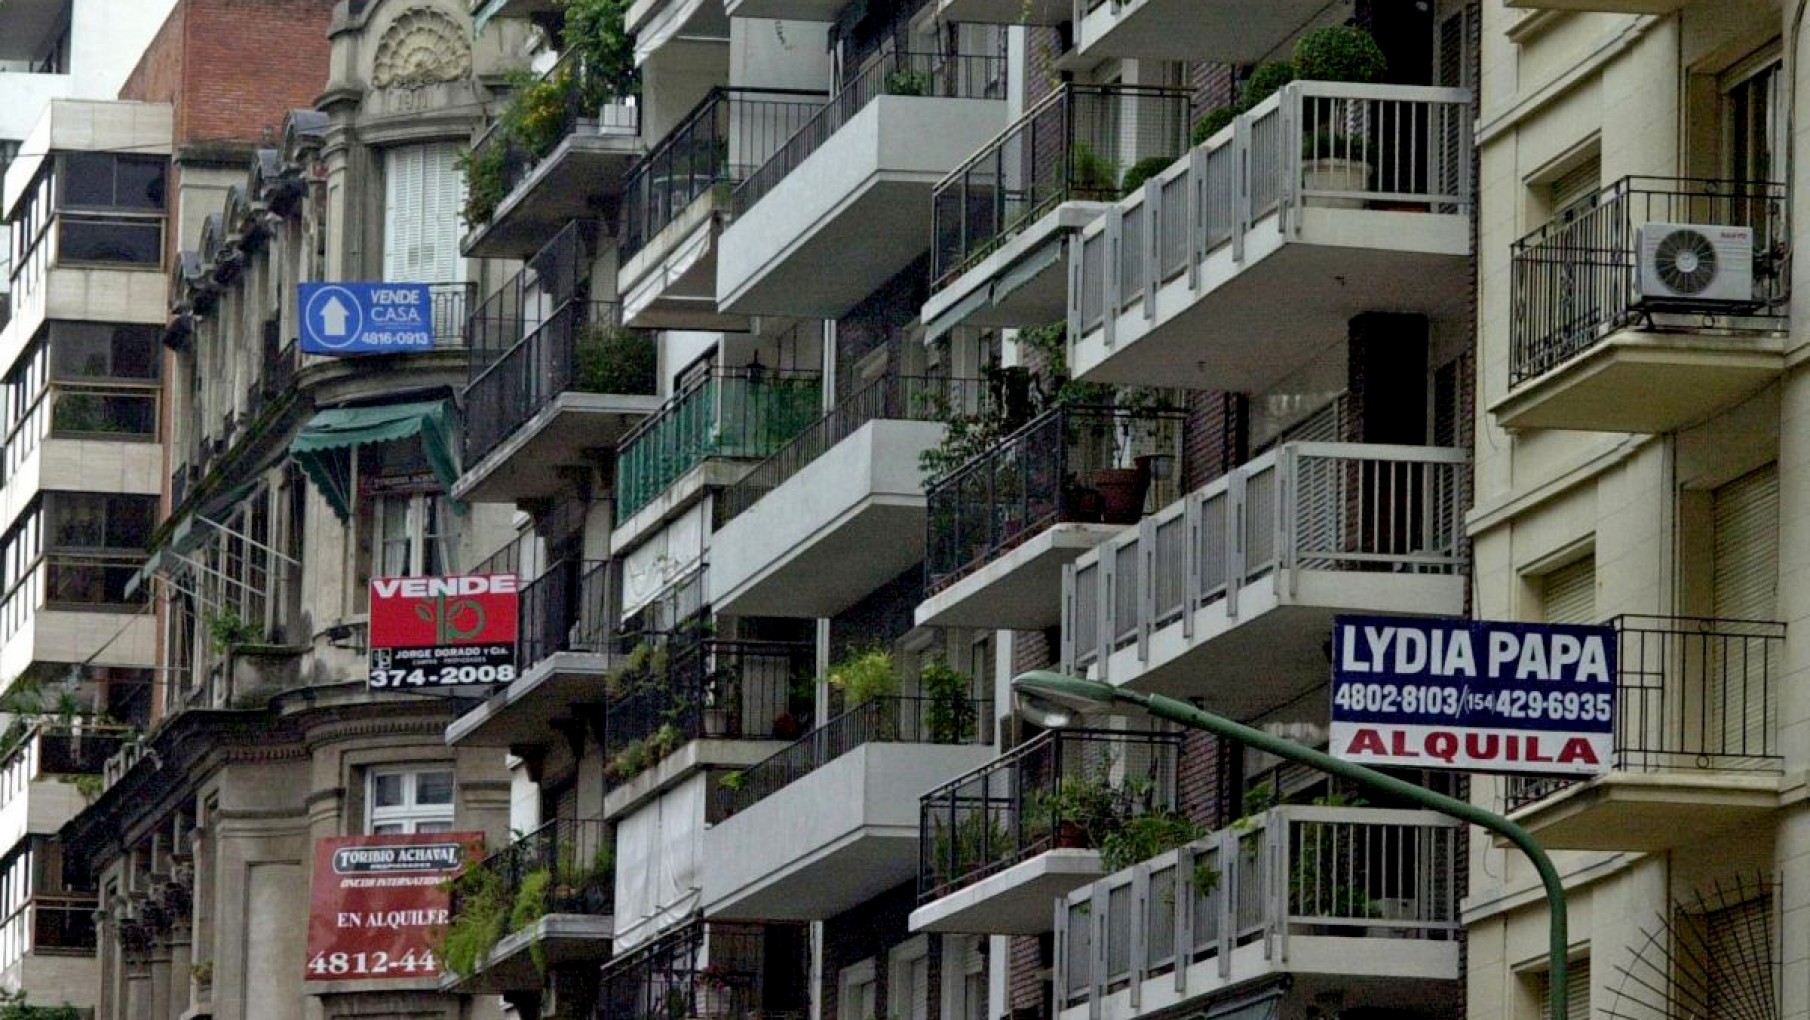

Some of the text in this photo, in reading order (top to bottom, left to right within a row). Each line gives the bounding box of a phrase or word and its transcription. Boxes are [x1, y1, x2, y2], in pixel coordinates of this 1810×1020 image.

[371, 289, 420, 304] VENDE
[371, 307, 421, 322] CASA
[362, 331, 428, 345] 4816-0913
[373, 575, 517, 598] VENDE
[395, 649, 433, 659] JORGE
[434, 647, 481, 657] DORADO
[1342, 625, 1609, 683] LYDIA PAPA
[370, 664, 515, 687] 374-2008
[1346, 729, 1599, 765] ALQUILA
[340, 850, 395, 867] TORIBIO
[398, 847, 457, 864] ACHAVAL
[337, 912, 362, 928] EN
[308, 948, 437, 974] 4812-44
